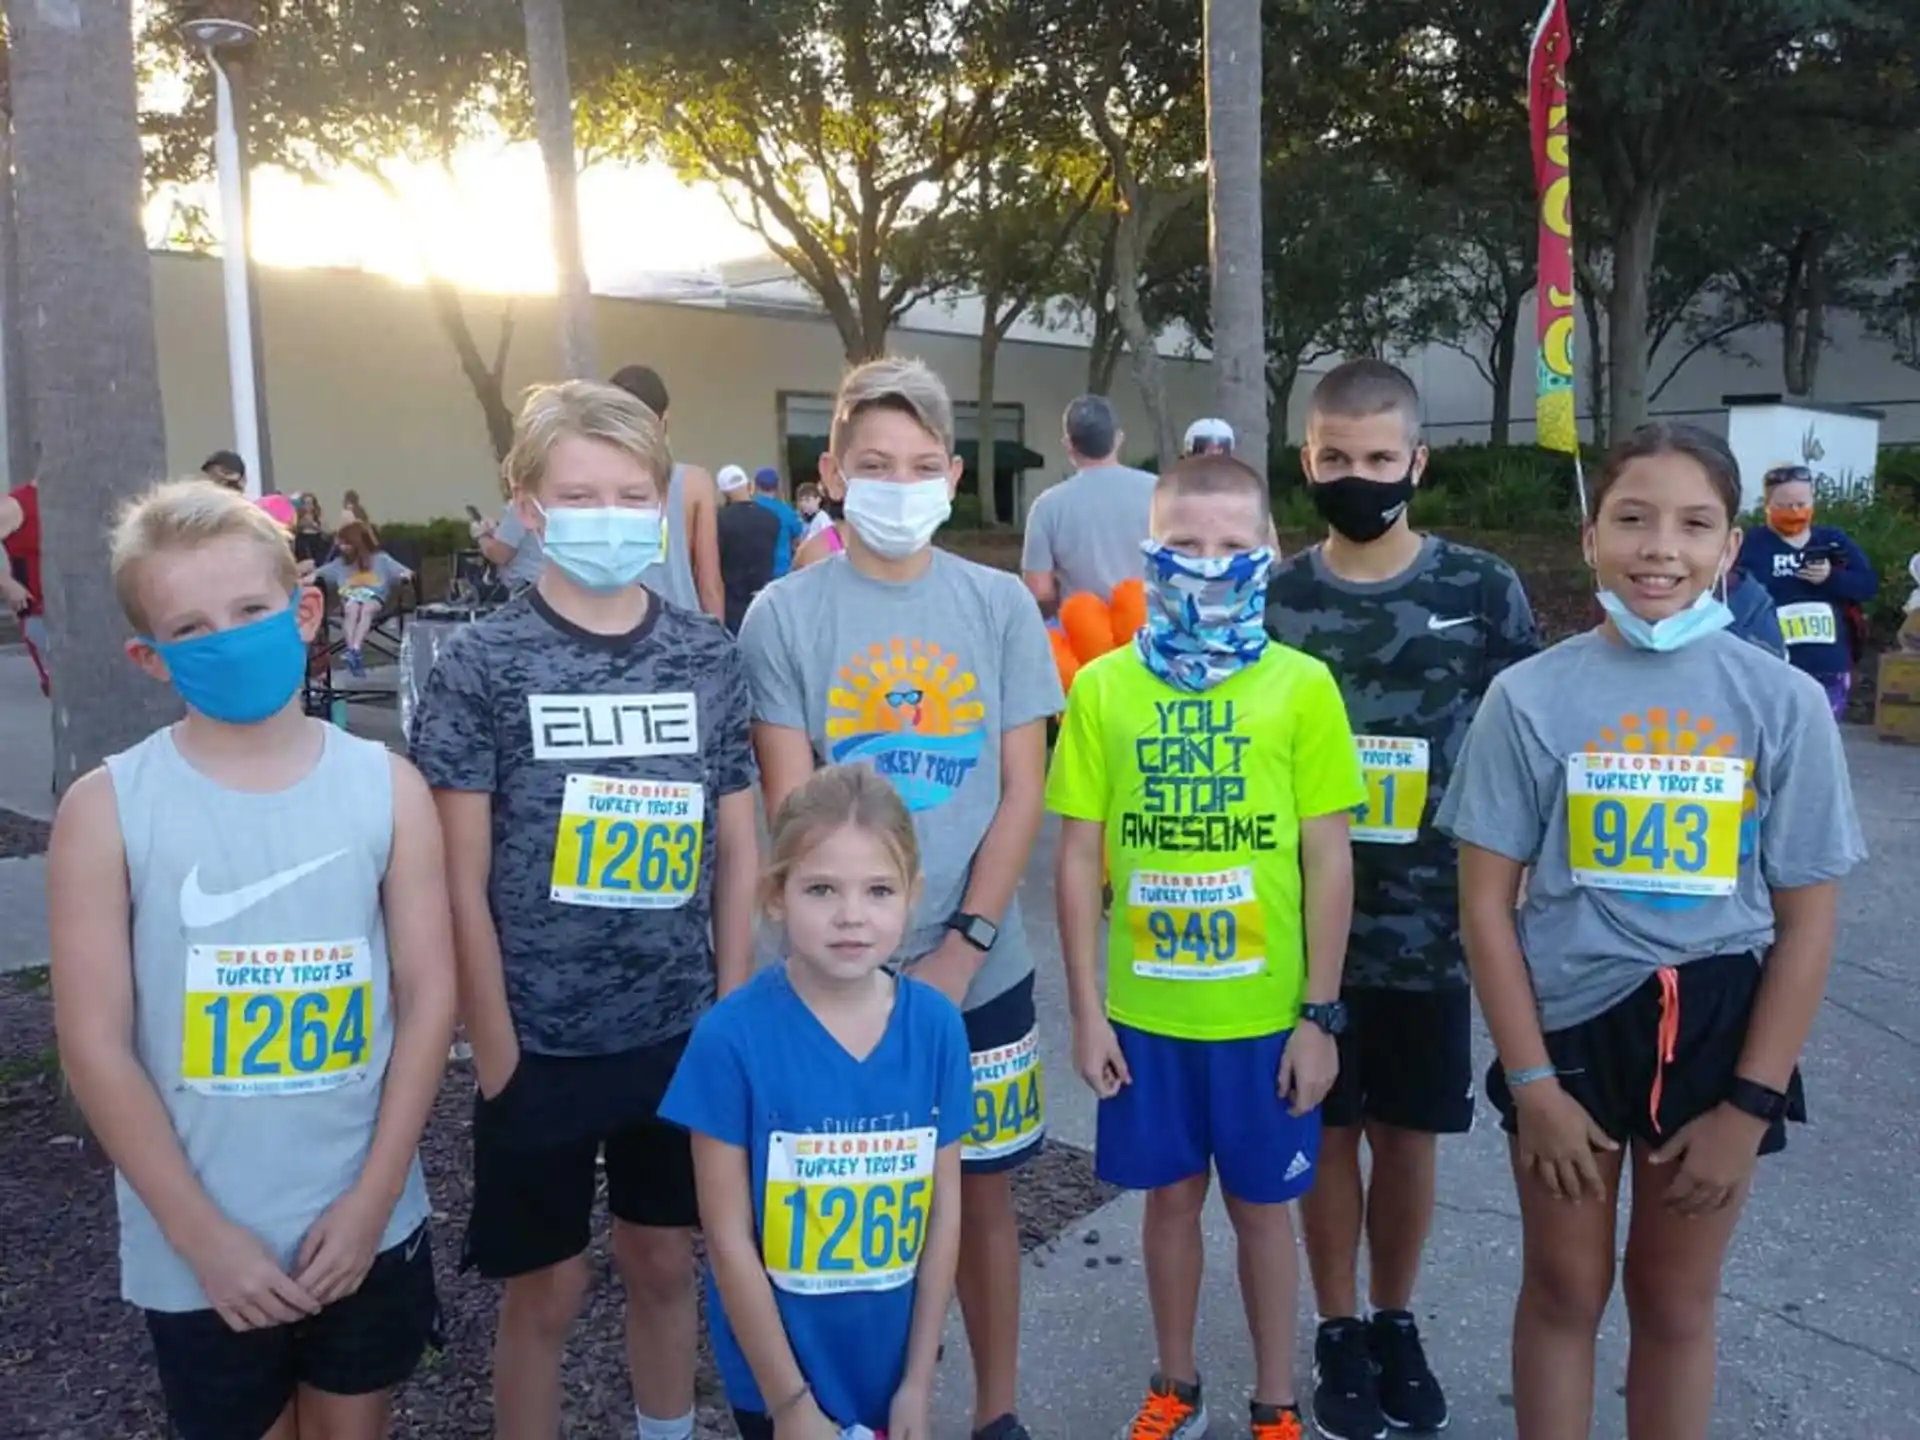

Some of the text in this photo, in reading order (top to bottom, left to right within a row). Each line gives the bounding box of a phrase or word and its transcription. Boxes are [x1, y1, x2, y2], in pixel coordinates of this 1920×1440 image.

[1787, 616, 1831, 637] 1190
[541, 704, 690, 747] ELITE
[1154, 700, 1233, 733] YOU
[1603, 758, 1706, 772] FLORIDA
[1144, 777, 1244, 812] STOP
[1585, 772, 1725, 793] TURKEY TROT 5K
[588, 796, 642, 813] TURKEY
[647, 800, 674, 815] TROT
[1122, 813, 1277, 851] AWESOME
[1593, 800, 1708, 872] 943
[576, 819, 696, 891] 1263
[1148, 910, 1236, 962] 940
[235, 948, 340, 965] FLORIDA
[216, 963, 353, 986] TURKEY TROT 5K
[204, 986, 367, 1076] 1264
[971, 1071, 1040, 1142] 944
[814, 1138, 906, 1153] FLORIDA
[796, 1154, 917, 1178] TURKEY TROT 5K
[784, 1181, 926, 1271] 1265
